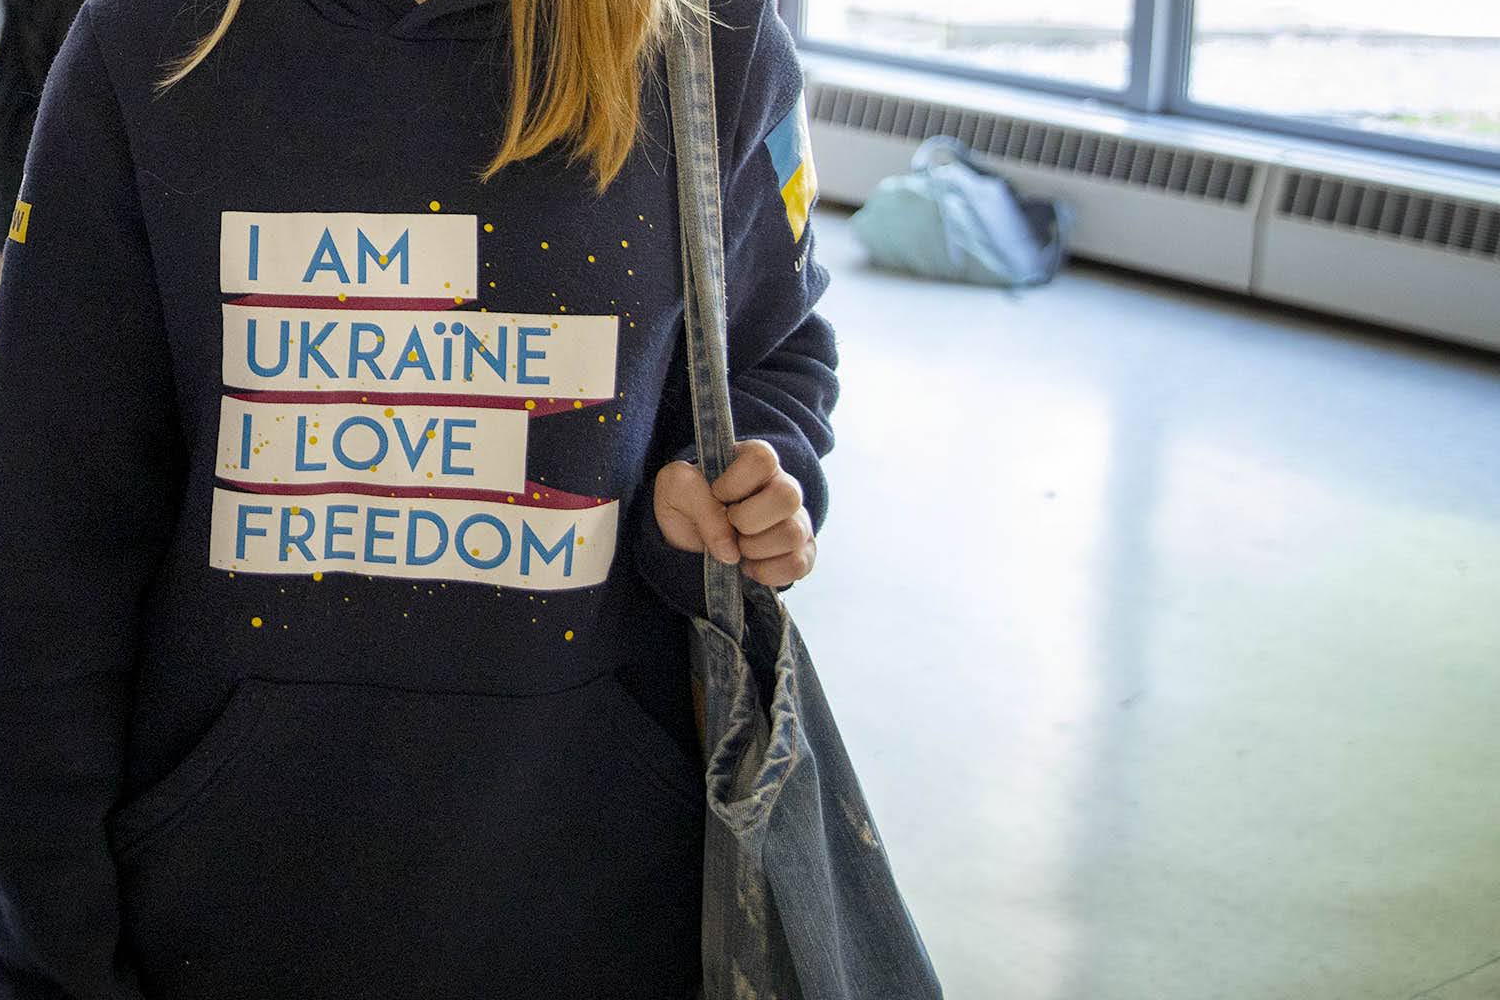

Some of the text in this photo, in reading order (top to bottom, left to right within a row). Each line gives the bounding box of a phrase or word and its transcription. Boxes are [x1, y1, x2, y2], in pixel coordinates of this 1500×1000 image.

[249, 225, 410, 285] I AM
[240, 414, 477, 476] I LOVE
[235, 505, 576, 577] FREEDOM
